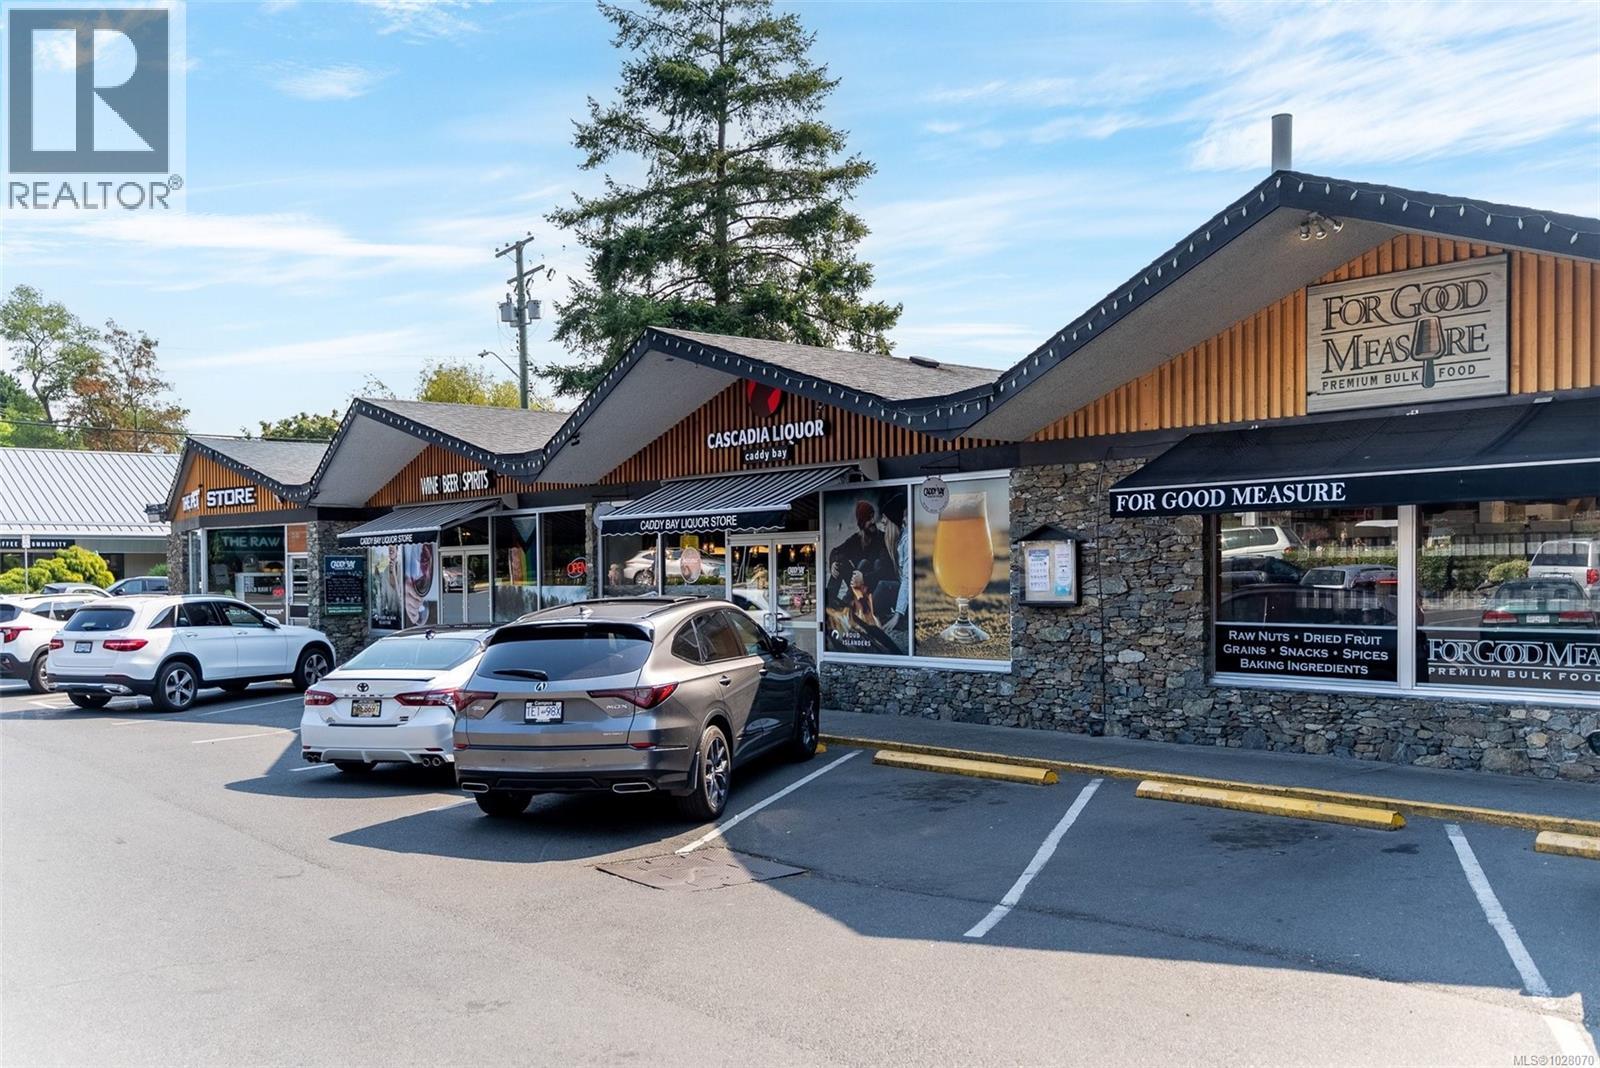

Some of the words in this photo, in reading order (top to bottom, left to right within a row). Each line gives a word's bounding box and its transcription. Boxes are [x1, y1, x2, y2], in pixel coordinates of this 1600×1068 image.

[1322, 294, 1382, 332] FOR
[1391, 277, 1488, 320] GOOD
[1321, 374, 1379, 392] PREMIUM
[1384, 370, 1420, 385] BULK
[1438, 363, 1477, 379] FOOD
[707, 426, 770, 449] CASCADIA
[772, 419, 825, 445] LIQUOR
[745, 450, 770, 462] caddy
[771, 448, 788, 460] bay
[420, 475, 439, 496] WINE
[442, 474, 460, 493] BEER
[462, 469, 489, 491] SPIRITS
[206, 487, 256, 507] STORE
[1115, 493, 1157, 513] FOR
[1161, 488, 1226, 510] GOOD
[1231, 481, 1347, 507] MEASURE
[640, 520, 664, 531] CADDY
[665, 519, 680, 530] BAY
[681, 517, 709, 529] LIQUOR
[711, 515, 738, 527] STORE
[221, 536, 247, 548] THE
[250, 536, 281, 548] RAW
[1228, 630, 1256, 642] RAW
[1258, 631, 1290, 643] NUTS
[1303, 632, 1343, 645] DRIED
[1344, 633, 1383, 646] FRUIT
[1223, 644, 1267, 656] GRAINS
[1279, 646, 1329, 659] SNACKS
[1342, 648, 1389, 661] SPICES
[1240, 658, 1285, 671] BAKING
[1287, 660, 1369, 675] INGREDIENTS
[1428, 667, 1500, 678] PREMIUM
[1507, 670, 1552, 680] BULK
